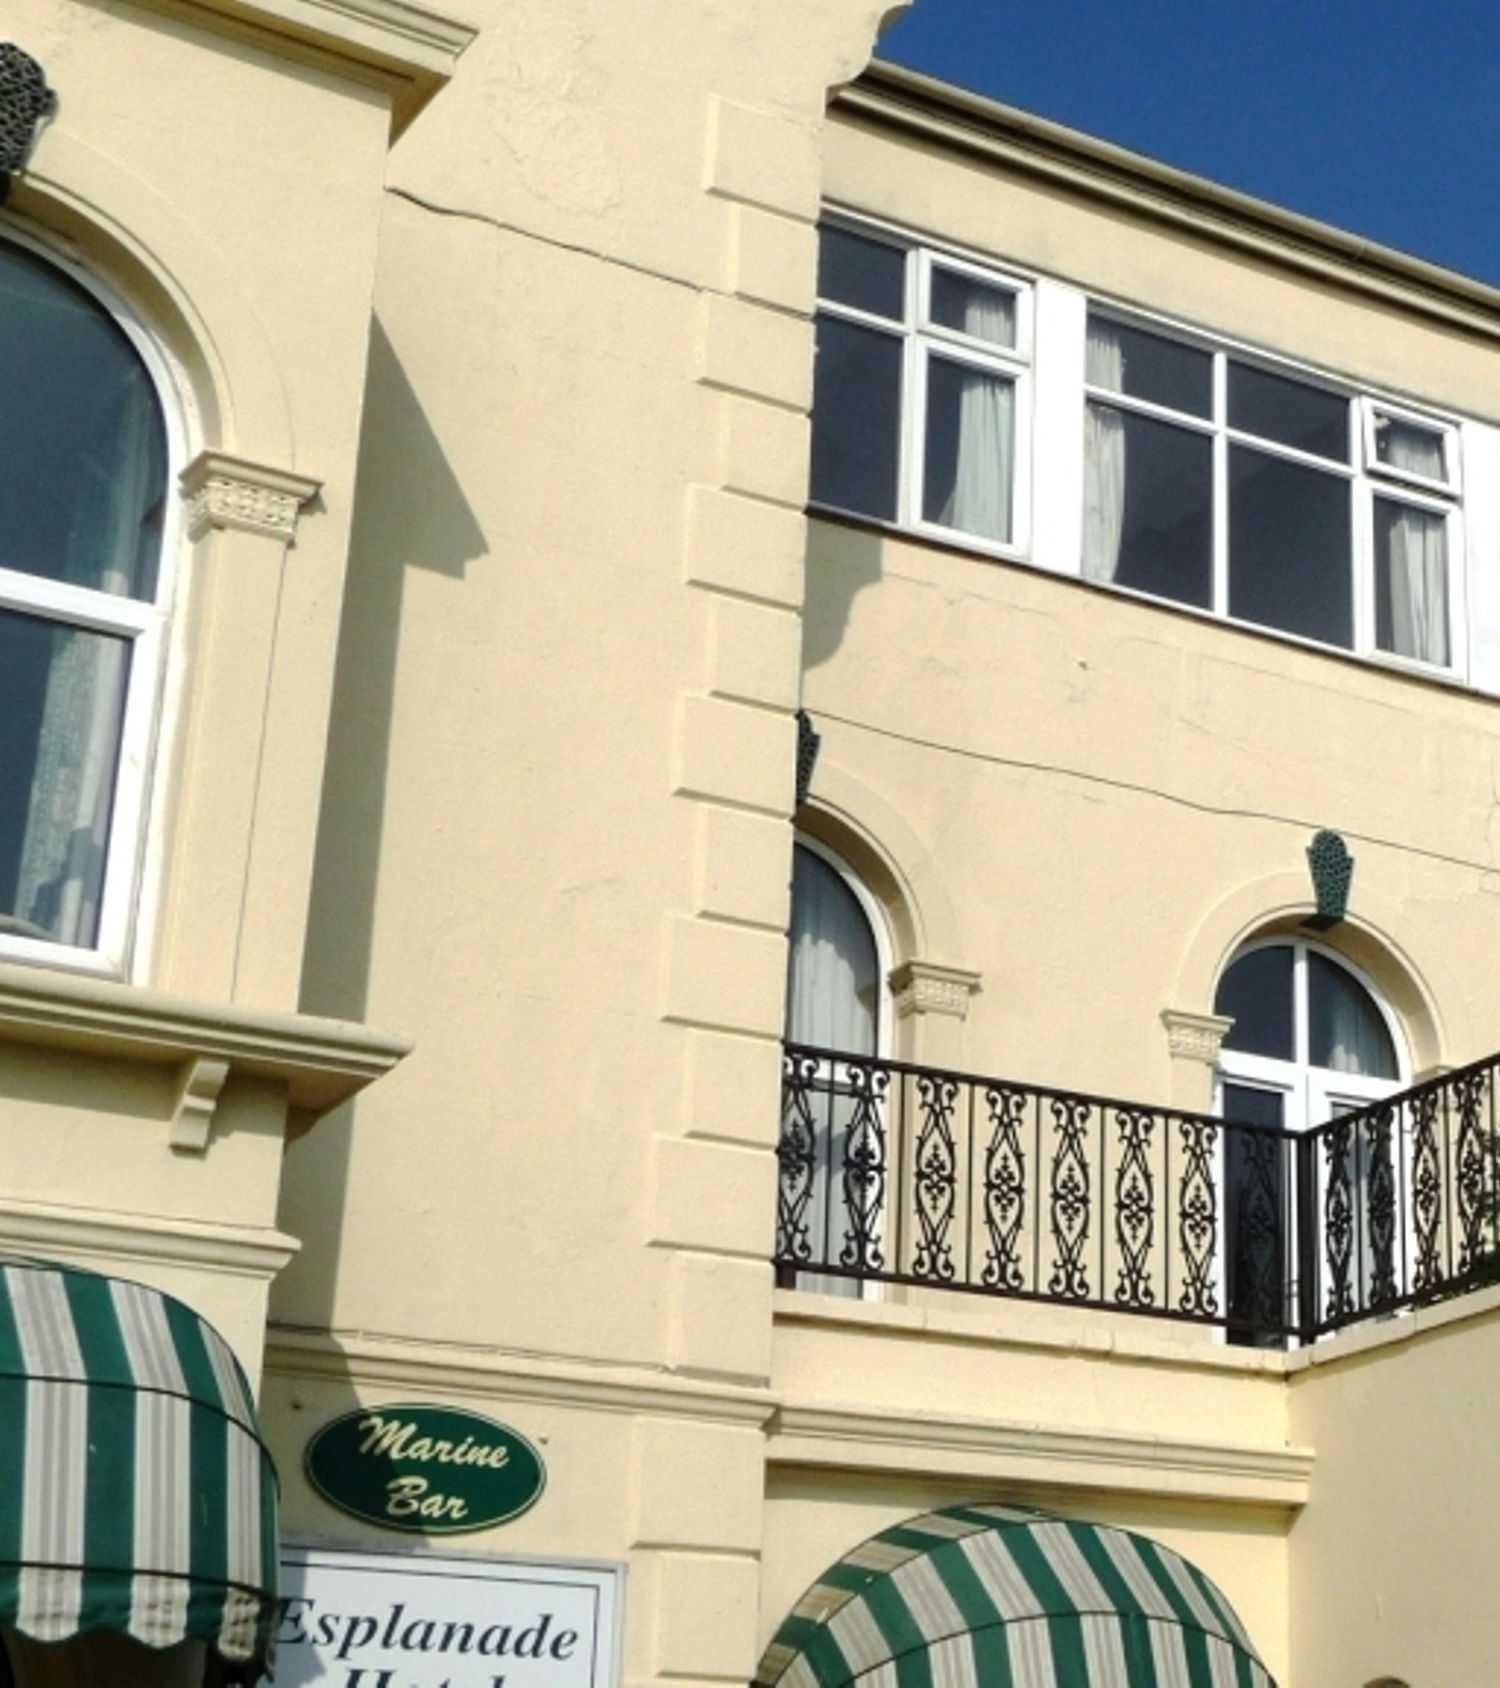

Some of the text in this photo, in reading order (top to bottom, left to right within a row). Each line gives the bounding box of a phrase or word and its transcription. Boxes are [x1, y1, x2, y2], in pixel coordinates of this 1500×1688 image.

[359, 1415, 510, 1469] Marine
[385, 1476, 468, 1520] Bar
[276, 1597, 579, 1660] Esplanade
